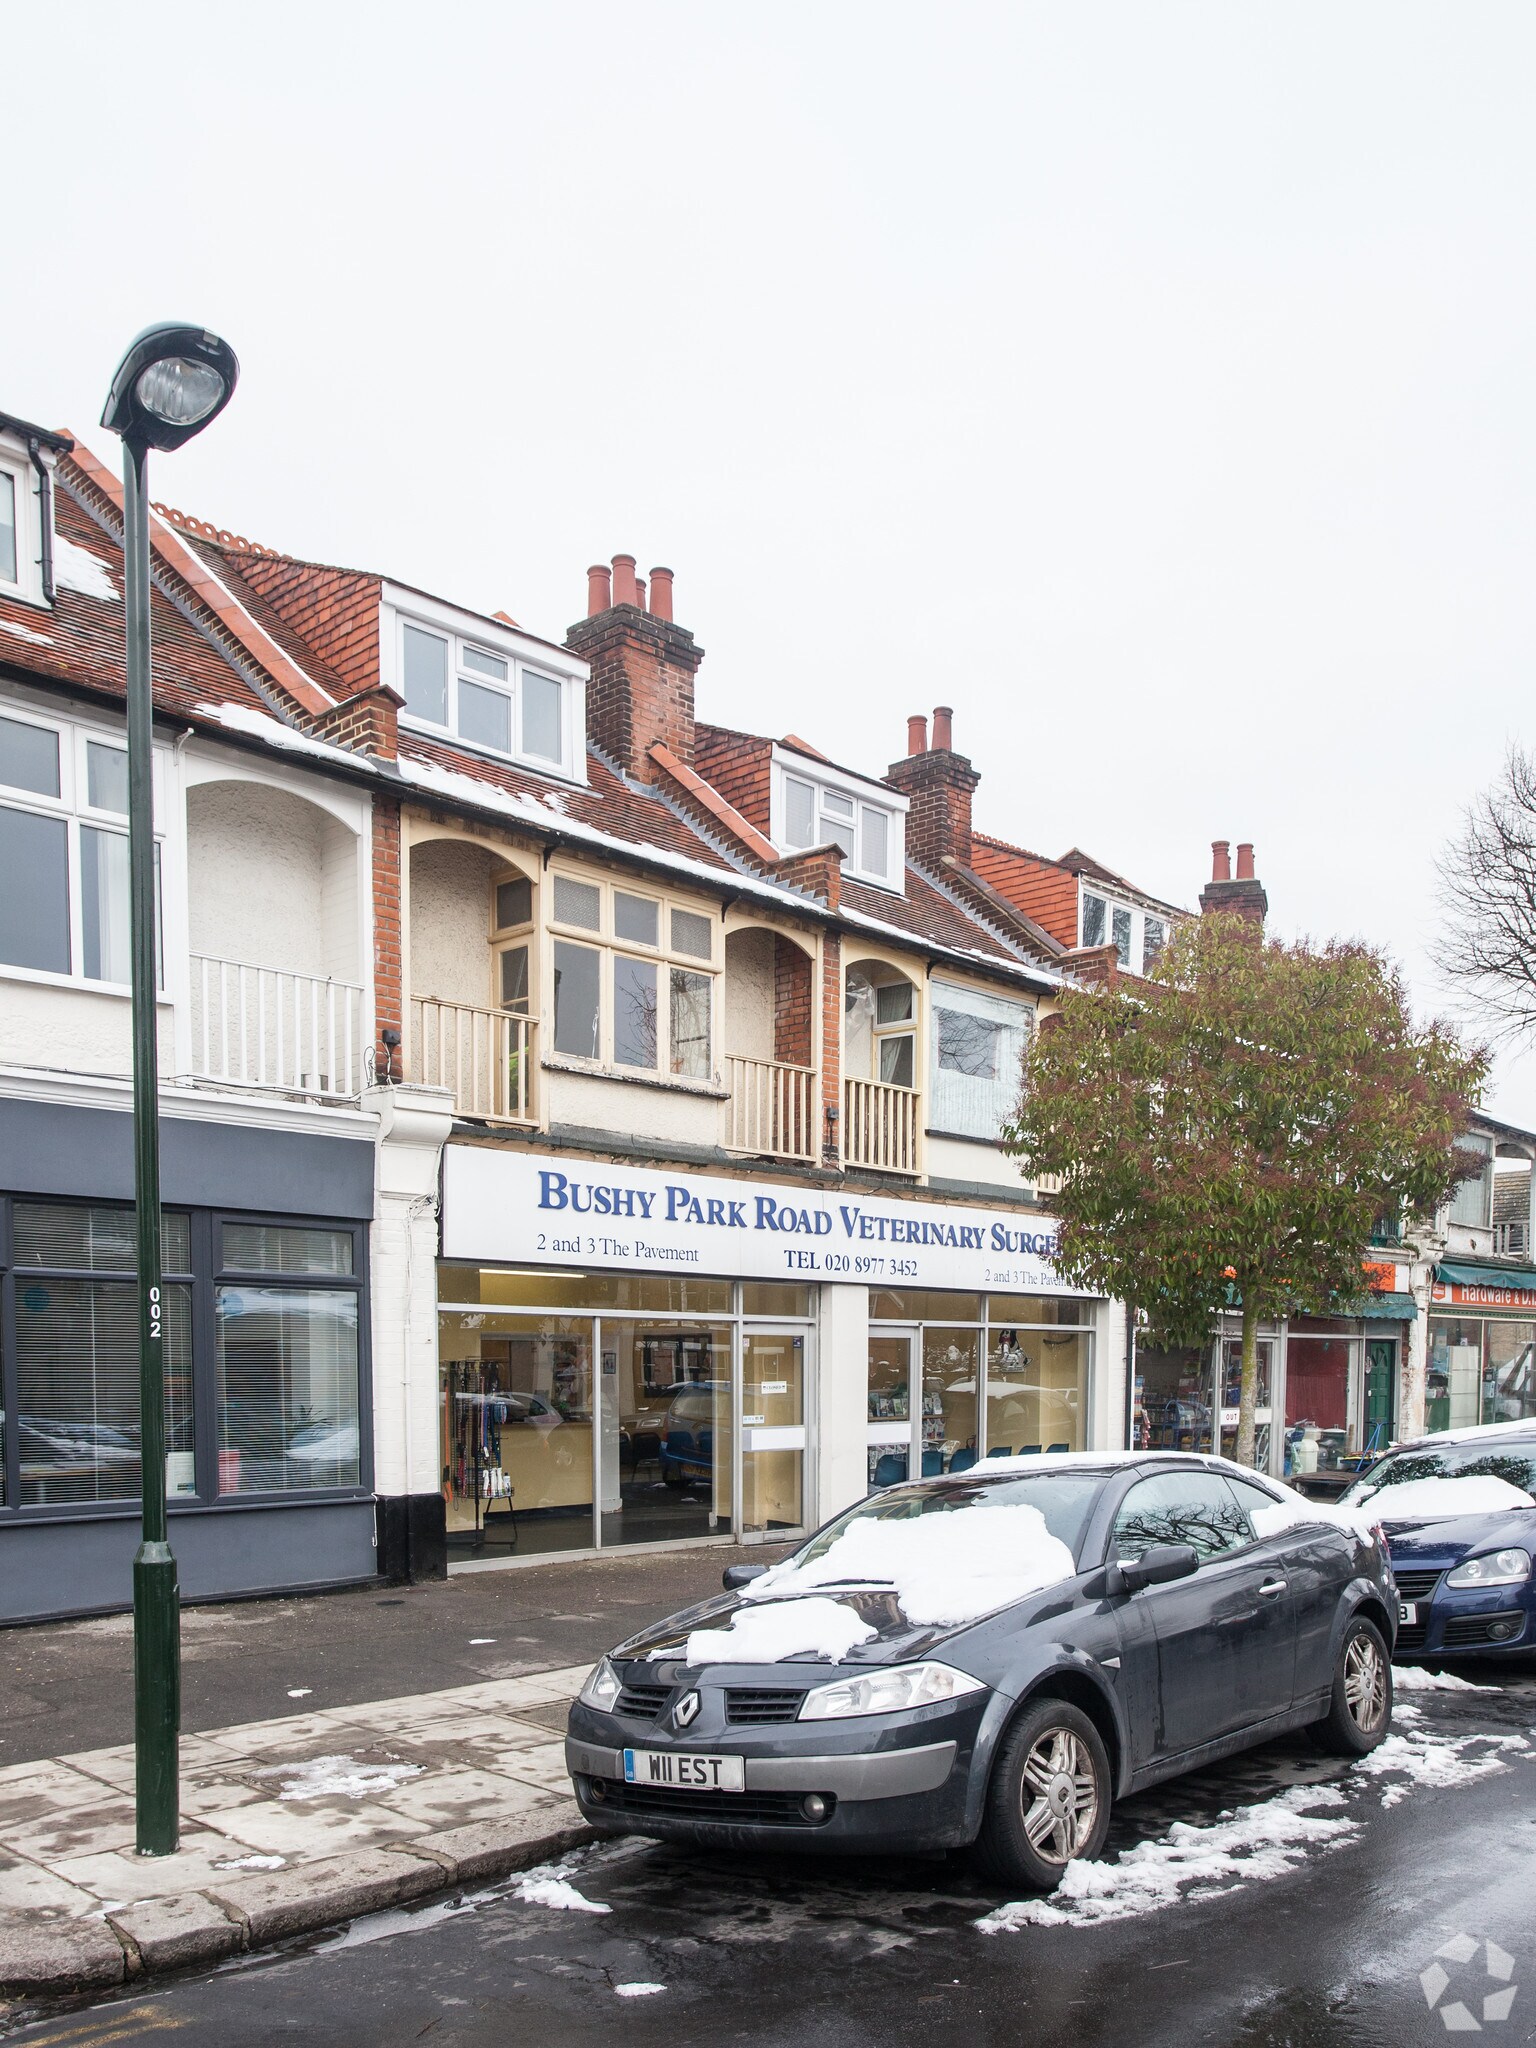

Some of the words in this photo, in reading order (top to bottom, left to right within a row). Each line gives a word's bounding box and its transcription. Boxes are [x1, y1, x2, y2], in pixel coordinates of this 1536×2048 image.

[538, 1170, 656, 1219] BUSHY
[665, 1185, 748, 1229] PARK
[753, 1195, 833, 1236] ROAD
[839, 1205, 987, 1250] VETERINARY
[990, 1222, 1062, 1257] SURGE
[536, 1233, 546, 1251] 2
[552, 1235, 581, 1253] and
[587, 1237, 596, 1254] 3
[599, 1237, 630, 1258] The
[635, 1240, 700, 1262] Pavement
[783, 1249, 821, 1272] TEL
[824, 1253, 850, 1273] 020
[854, 1255, 885, 1276] 8977
[889, 1258, 918, 1277] 3452
[984, 1268, 991, 1282] 2
[993, 1270, 1010, 1283] and
[1013, 1271, 1019, 1284] 3
[1020, 1271, 1038, 1285] The
[1461, 1284, 1512, 1304] Hardware
[1514, 1290, 1520, 1305] &
[149, 1286, 162, 1338] 002
[678, 1757, 723, 1786] EST
